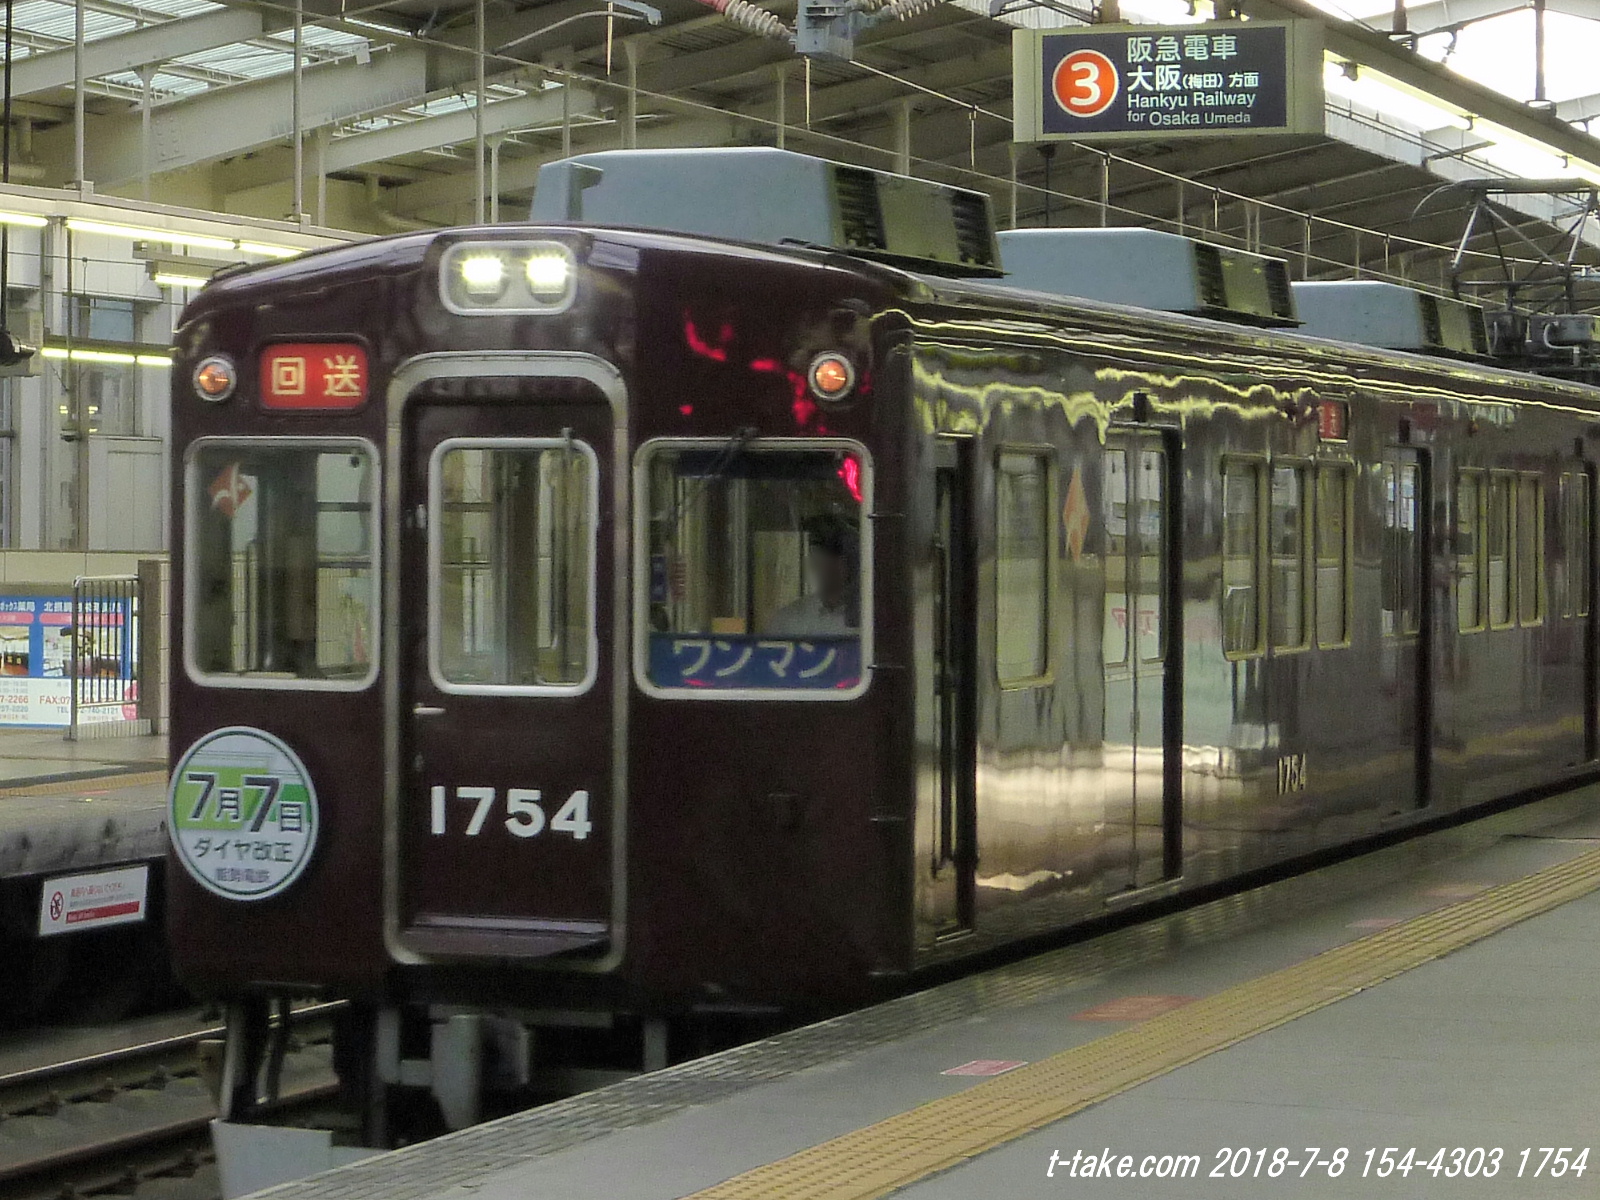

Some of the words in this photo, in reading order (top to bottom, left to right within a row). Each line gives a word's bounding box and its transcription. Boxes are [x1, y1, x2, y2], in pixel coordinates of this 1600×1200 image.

[1127, 34, 1238, 63] 阪急電車
[1069, 61, 1101, 106] 3
[1127, 93, 1188, 110] Hankyu
[1193, 92, 1256, 108] Railway
[1127, 111, 1146, 123] for
[1149, 111, 1200, 126] Osaka
[1204, 112, 1251, 125] Umeda
[271, 354, 362, 397] 回送
[672, 639, 837, 679] ワンマン
[1278, 753, 1306, 795] 1754
[186, 771, 303, 833] 7月7日
[431, 785, 592, 840] 1754
[194, 837, 293, 862] ダイヤ改正
